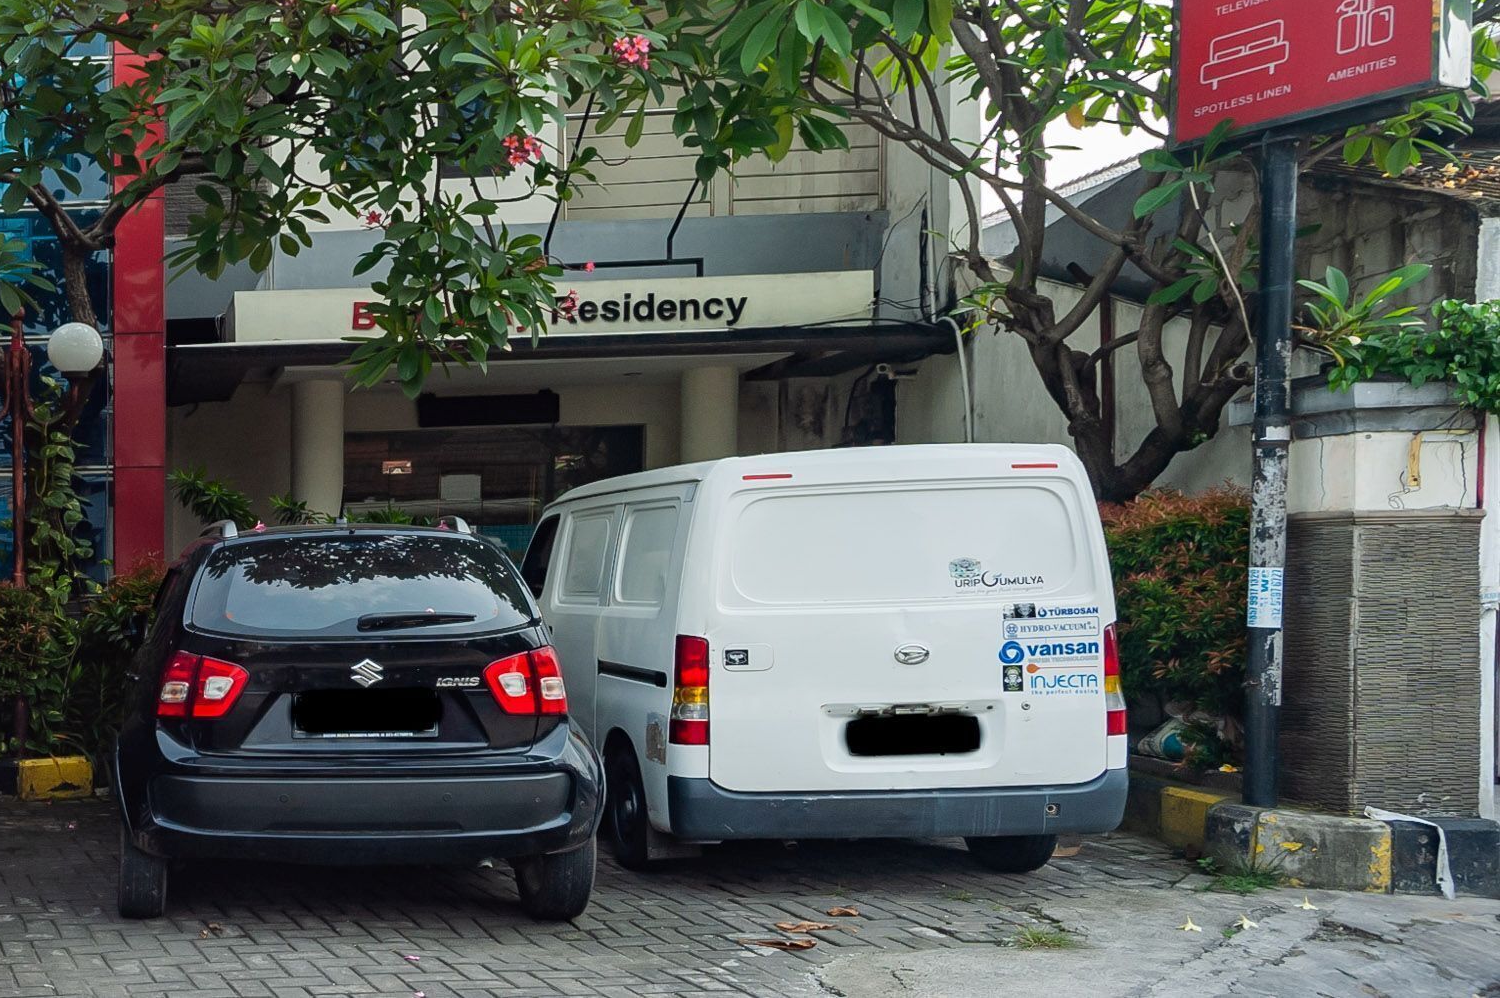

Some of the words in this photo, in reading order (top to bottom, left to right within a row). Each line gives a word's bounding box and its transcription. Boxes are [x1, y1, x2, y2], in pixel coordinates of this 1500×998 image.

[1327, 55, 1397, 83] AMENITIES
[1193, 92, 1254, 118] SPOTLESS
[1256, 83, 1292, 103] LINEN
[954, 578, 981, 588] URIP
[1047, 606, 1099, 616] TÜRBOSAN
[1026, 642, 1099, 656] vansan
[436, 677, 480, 687] IGNIS
